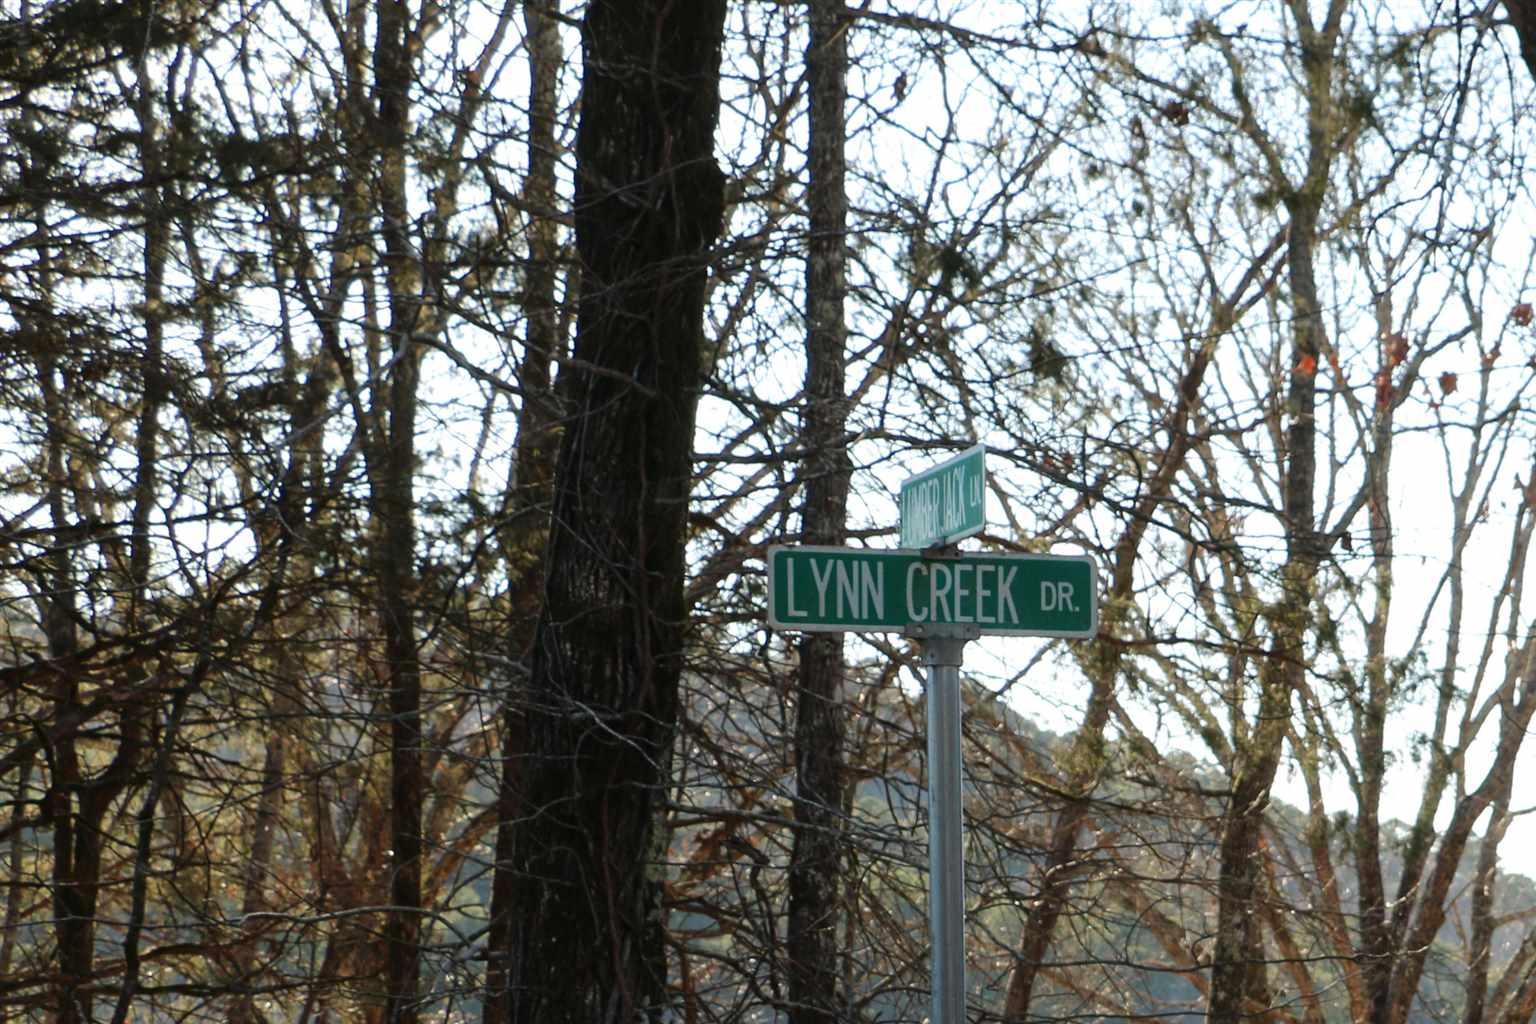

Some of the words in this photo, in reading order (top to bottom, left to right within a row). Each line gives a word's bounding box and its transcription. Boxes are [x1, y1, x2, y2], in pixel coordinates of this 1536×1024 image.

[786, 557, 885, 621] LYNN
[905, 560, 1020, 625] CREEK
[1040, 580, 1081, 613] DR.
